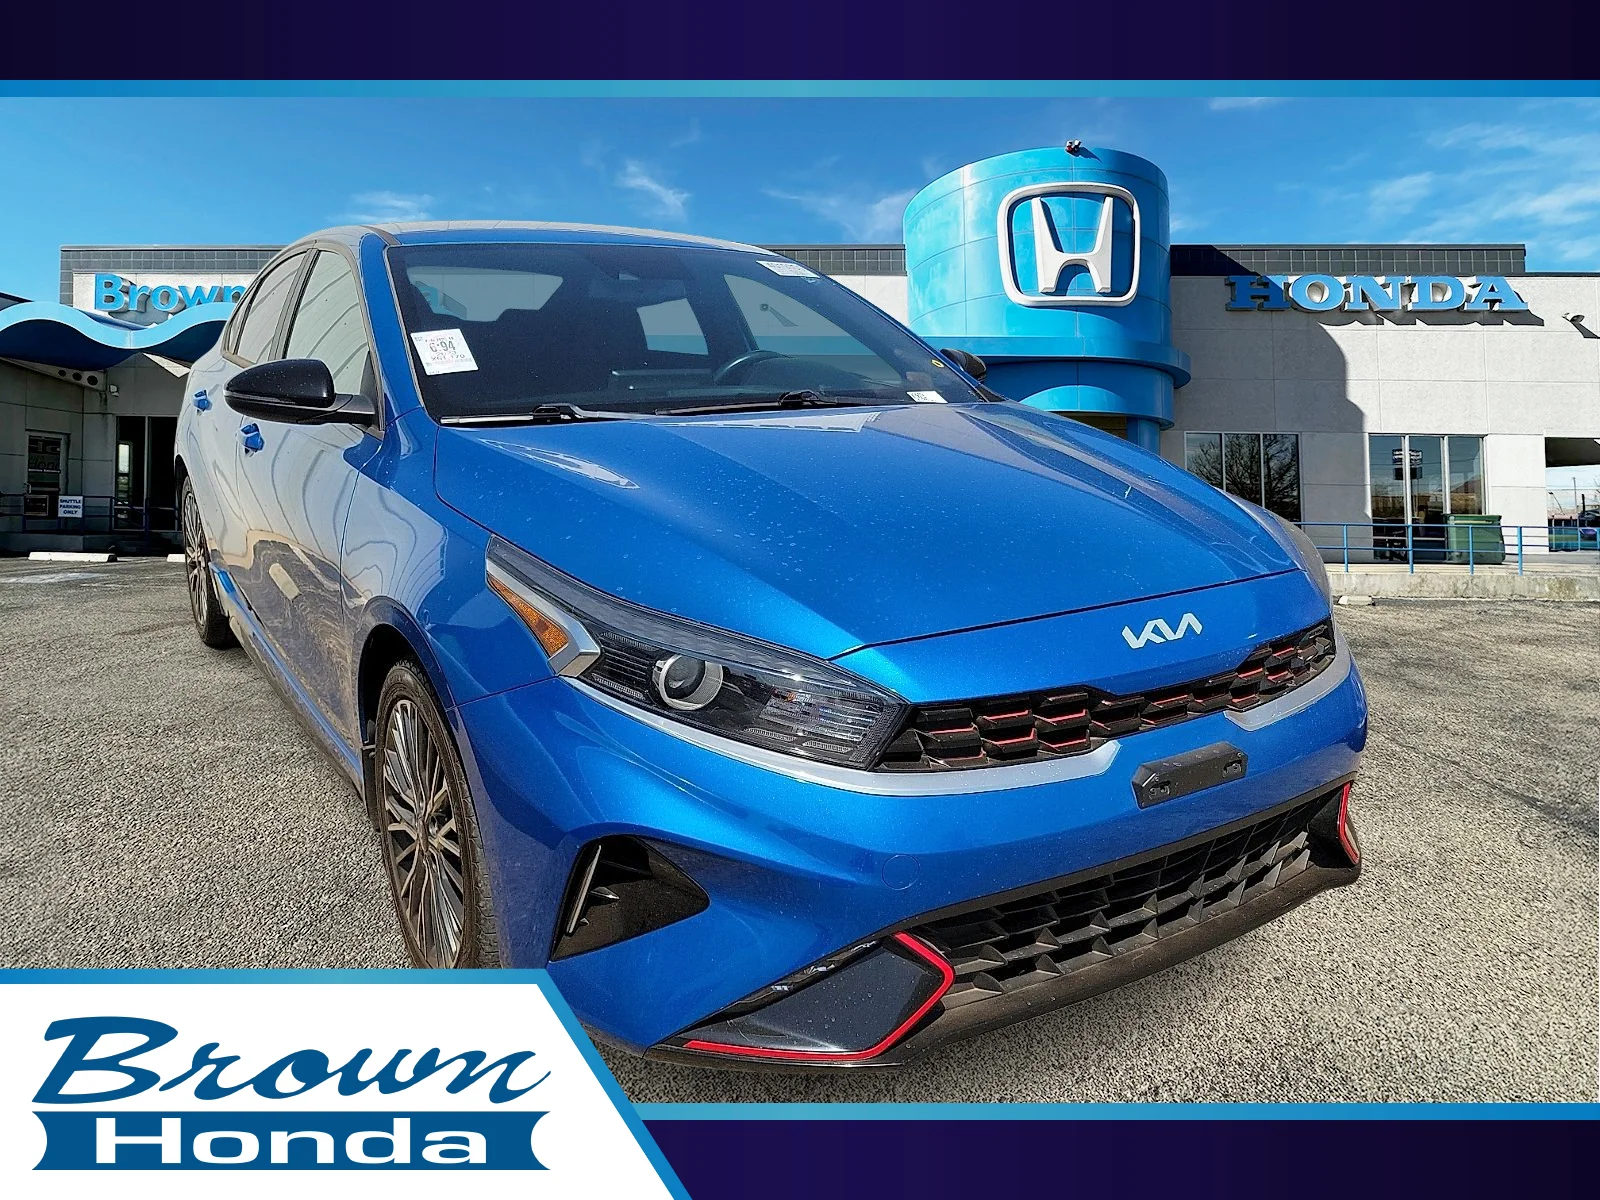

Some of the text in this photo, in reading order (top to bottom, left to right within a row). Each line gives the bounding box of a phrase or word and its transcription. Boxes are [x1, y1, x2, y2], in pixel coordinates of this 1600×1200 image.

[95, 273, 248, 311] Brown
[1225, 274, 1528, 312] HONDA
[1121, 612, 1203, 649] KIA
